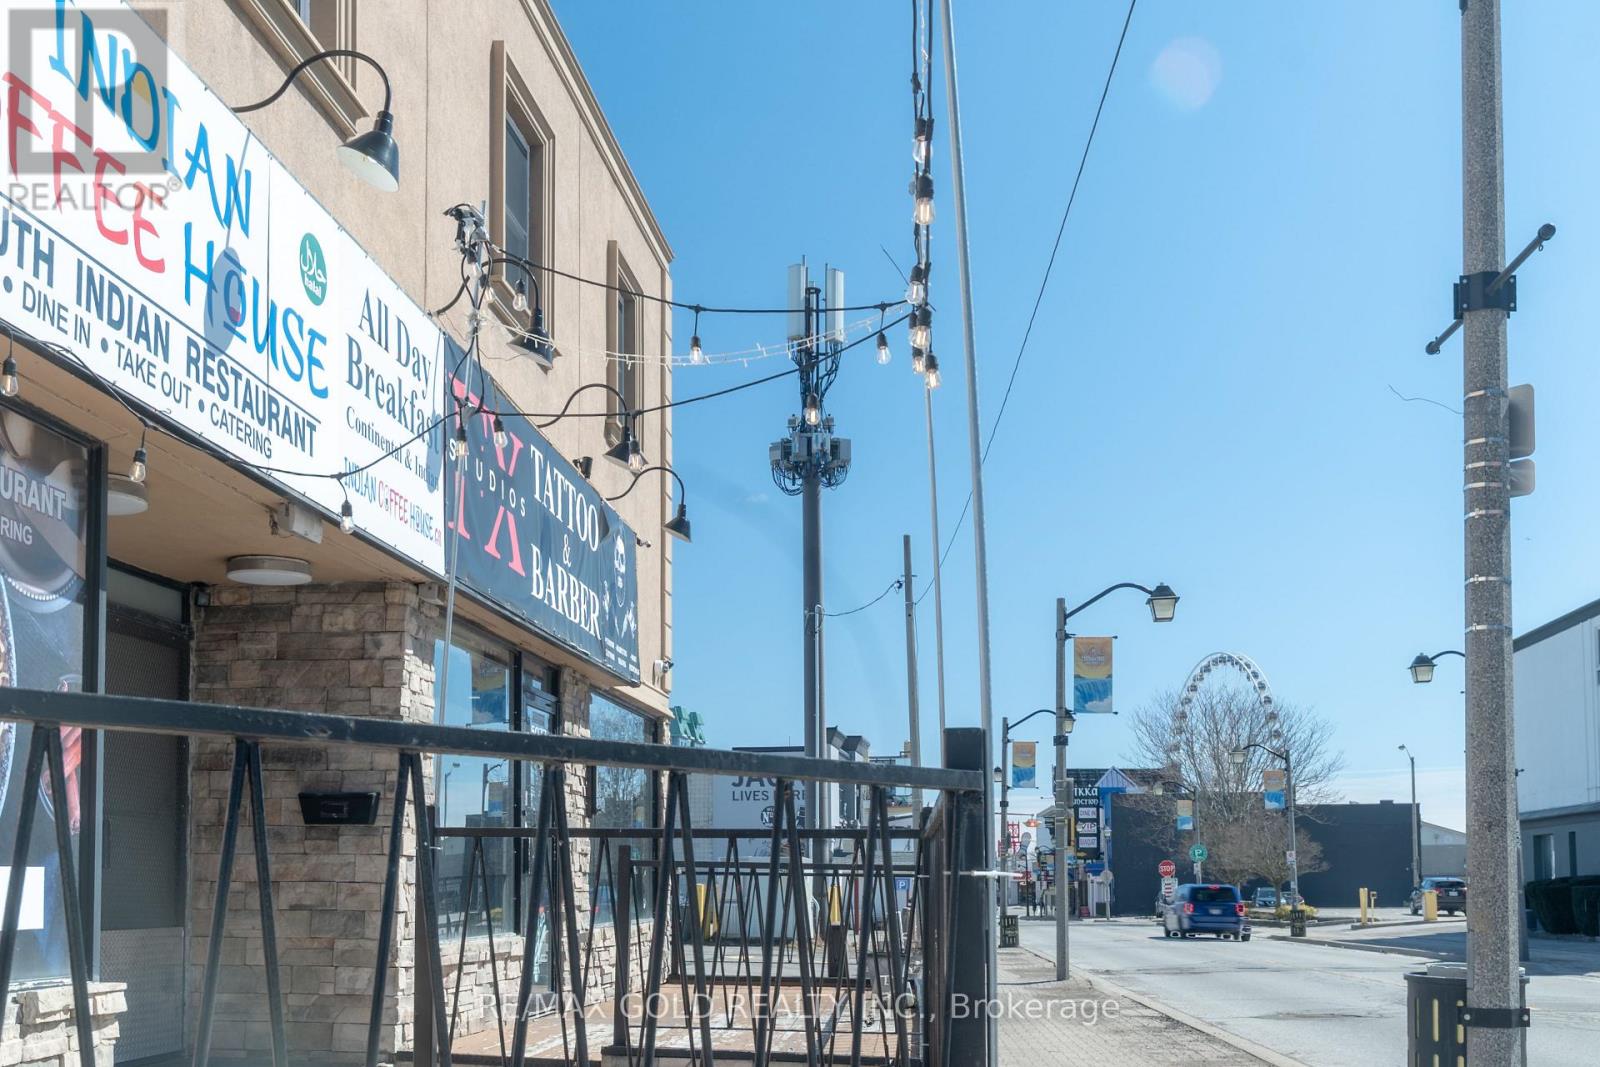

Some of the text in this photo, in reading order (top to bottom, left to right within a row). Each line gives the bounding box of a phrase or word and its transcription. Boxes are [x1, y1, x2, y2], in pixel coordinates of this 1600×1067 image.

[49, 0, 251, 239] INDIAN
[76, 258, 170, 364] INDIAN
[186, 336, 317, 457] RESTAURANT
[184, 222, 329, 399] HOUSE
[358, 288, 431, 399] All Day
[22, 281, 272, 459] DINE IN TAKE OUT CATERING
[346, 333, 440, 454] Breakfast
[346, 406, 402, 464] Continental
[404, 450, 413, 471] &
[530, 445, 600, 551] TATTOO
[562, 534, 572, 567] &
[530, 543, 602, 641] BARBER
[732, 790, 769, 801] LIVES
[899, 880, 906, 888] P
[1160, 865, 1174, 873] STOP
